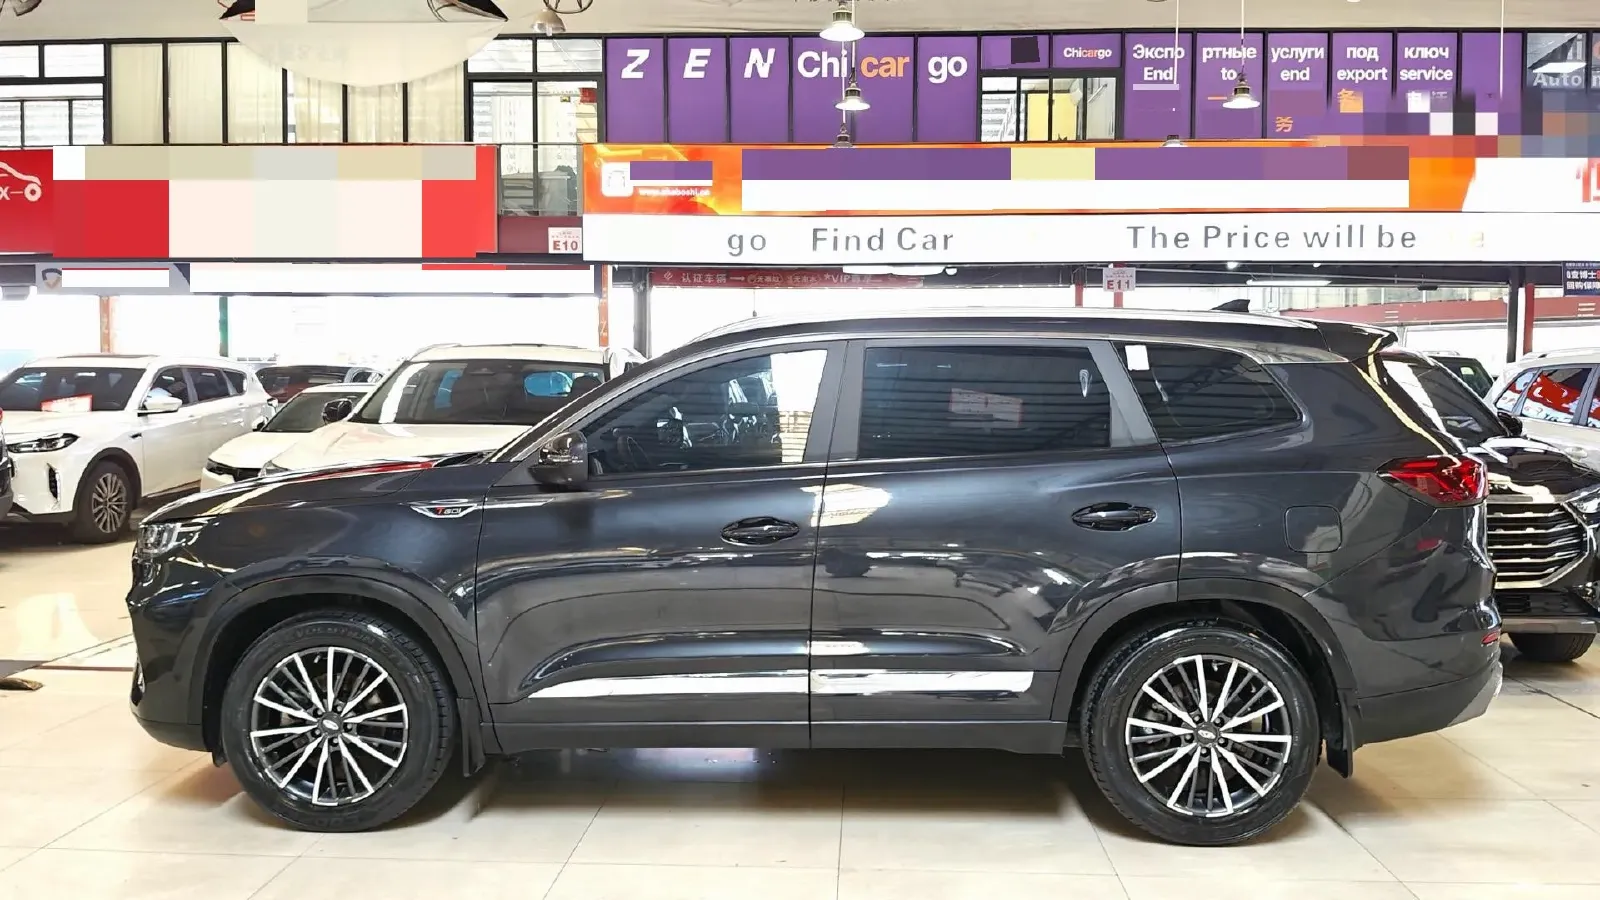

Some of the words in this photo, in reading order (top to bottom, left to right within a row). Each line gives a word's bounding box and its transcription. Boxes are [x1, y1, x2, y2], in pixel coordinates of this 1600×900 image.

[1063, 46, 1112, 59] Chicargo
[1132, 44, 1185, 60] Экспо
[1202, 47, 1257, 63] ртные
[1271, 46, 1324, 63] услуги
[1346, 46, 1379, 62] под
[1404, 46, 1449, 59] ключ
[621, 49, 650, 79] Z
[683, 48, 711, 79] E
[743, 48, 775, 79] N
[797, 50, 848, 78] Chi
[860, 55, 910, 78] car
[928, 55, 968, 84] go
[1143, 67, 1174, 81] End
[1220, 67, 1237, 81] to
[1280, 67, 1310, 81] end
[1337, 67, 1388, 83] export
[1400, 65, 1453, 81] service
[1532, 72, 1582, 87] Auto
[727, 233, 766, 257] go
[812, 227, 884, 252] Find
[897, 226, 954, 251] Car
[1126, 225, 1190, 249] The
[1203, 225, 1290, 249] Price
[1303, 224, 1365, 248] will
[1378, 224, 1416, 248] be
[552, 240, 579, 252] E10
[1106, 279, 1130, 290] E11
